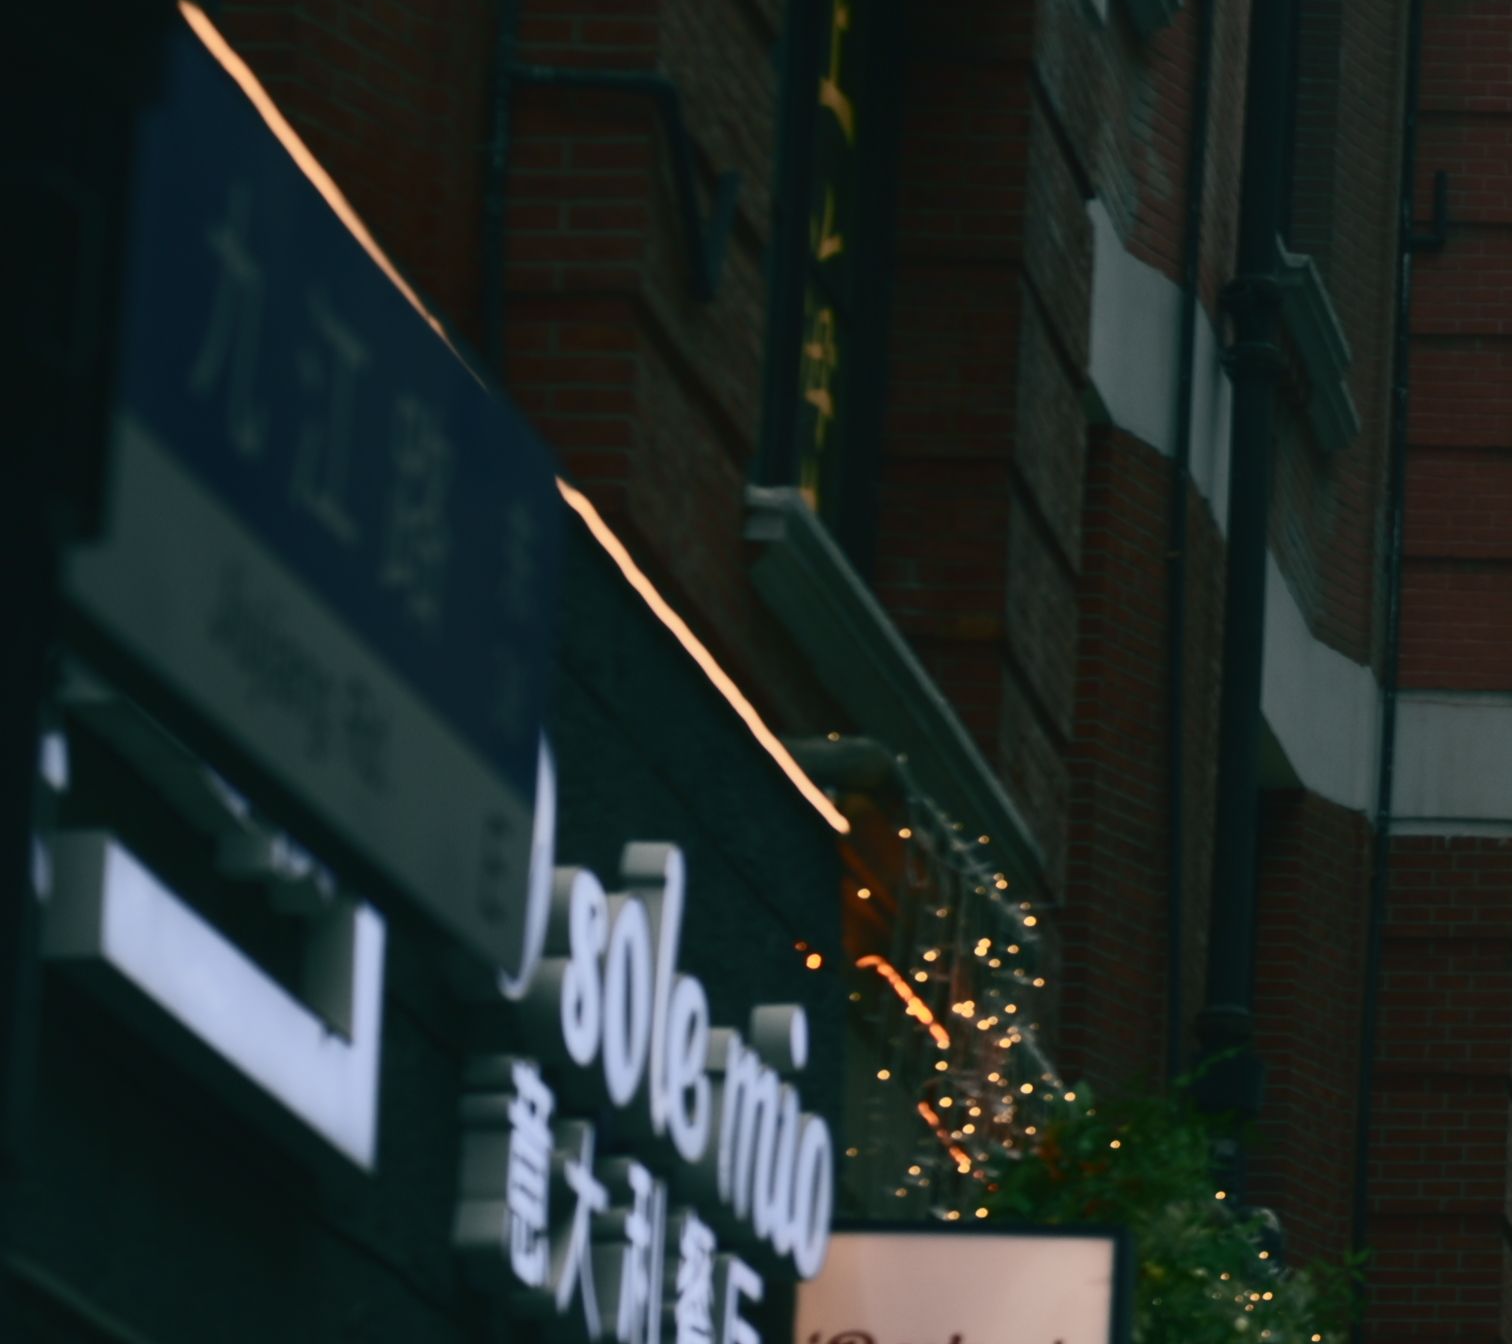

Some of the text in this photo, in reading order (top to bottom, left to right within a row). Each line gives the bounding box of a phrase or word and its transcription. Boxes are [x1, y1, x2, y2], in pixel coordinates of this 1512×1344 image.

[188, 176, 454, 631] 九江路
[562, 843, 833, 1281] sole mio
